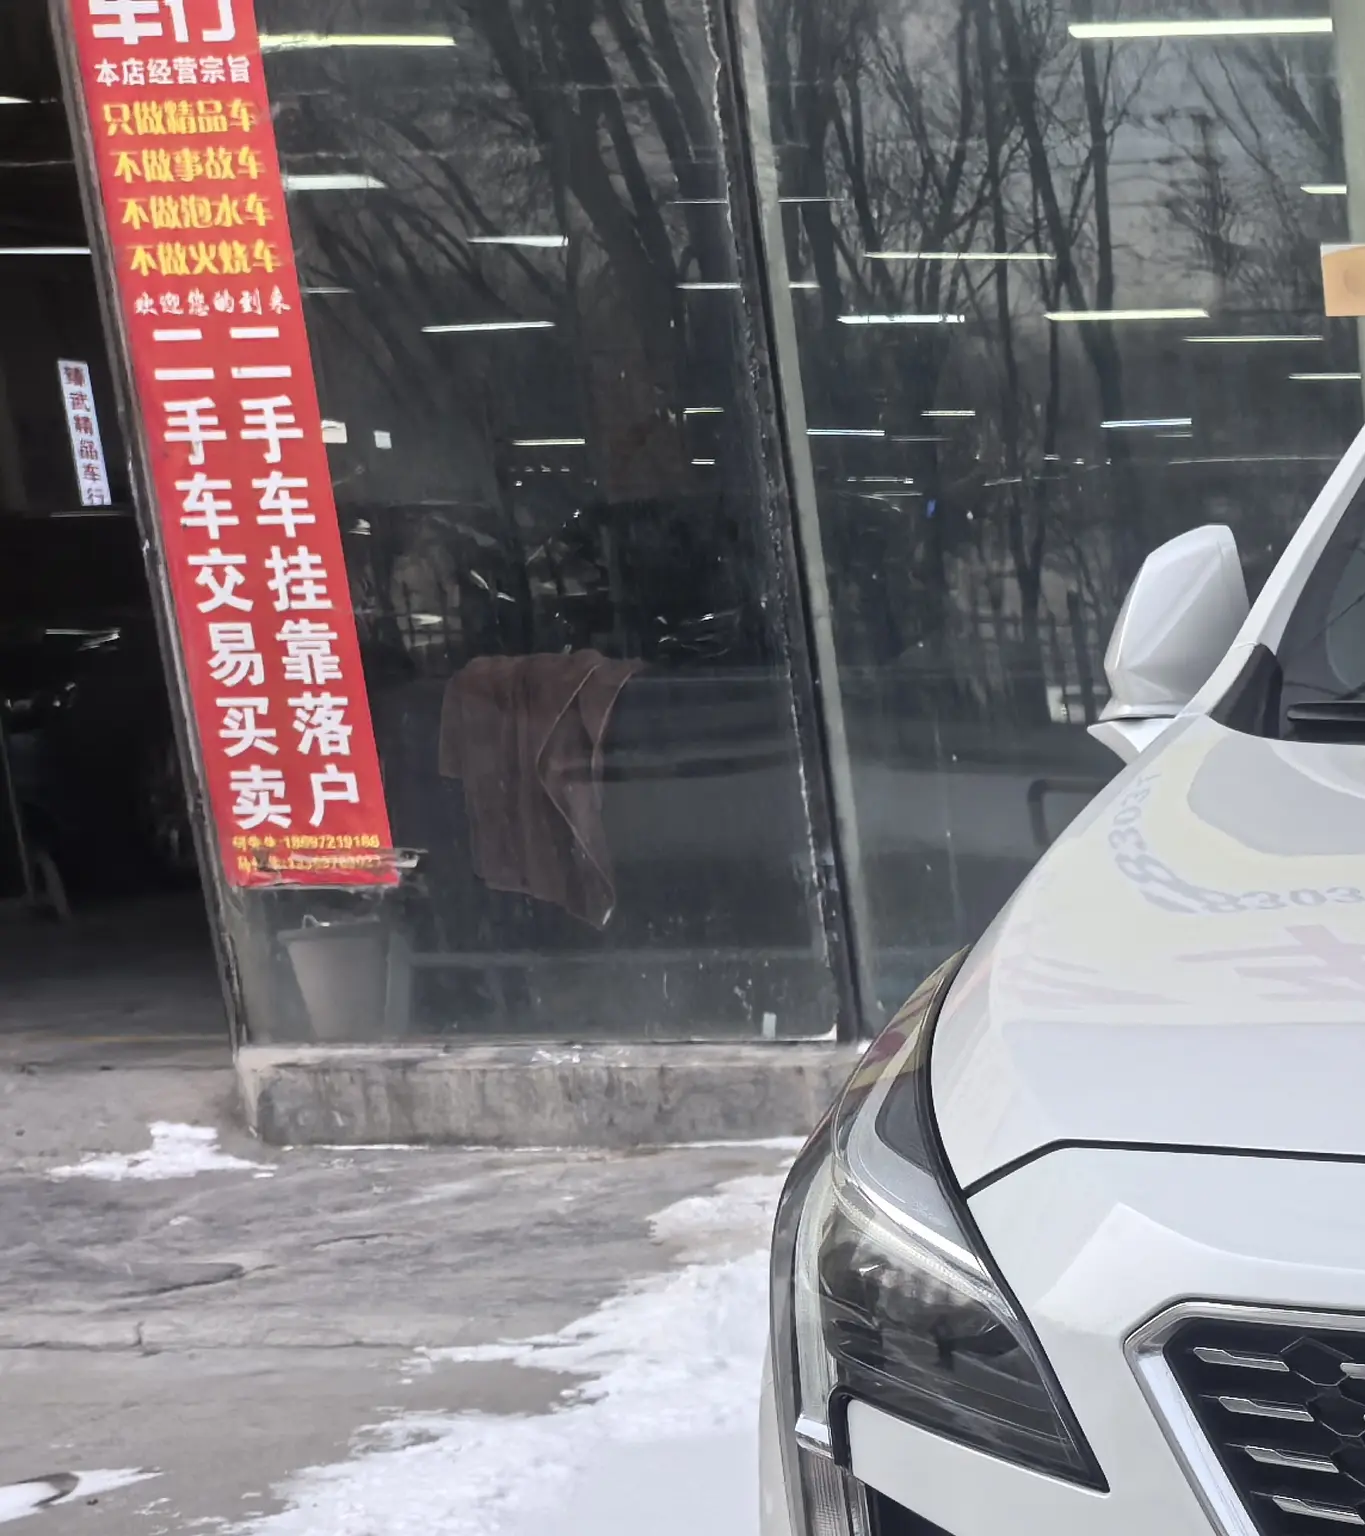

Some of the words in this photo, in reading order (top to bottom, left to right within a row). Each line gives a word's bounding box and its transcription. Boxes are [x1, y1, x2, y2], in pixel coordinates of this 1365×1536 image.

[94, 55, 251, 87] 本店经营宗旨
[103, 98, 257, 137] 只做精品车
[109, 146, 266, 184] 不做事故车
[118, 192, 274, 230] 不做泡水车
[127, 238, 282, 277] 不做火烧车
[134, 286, 292, 317] 欢迎您的到来
[152, 327, 293, 830] 二手车交易买卖
[229, 325, 361, 828] 二手车挂靠落户
